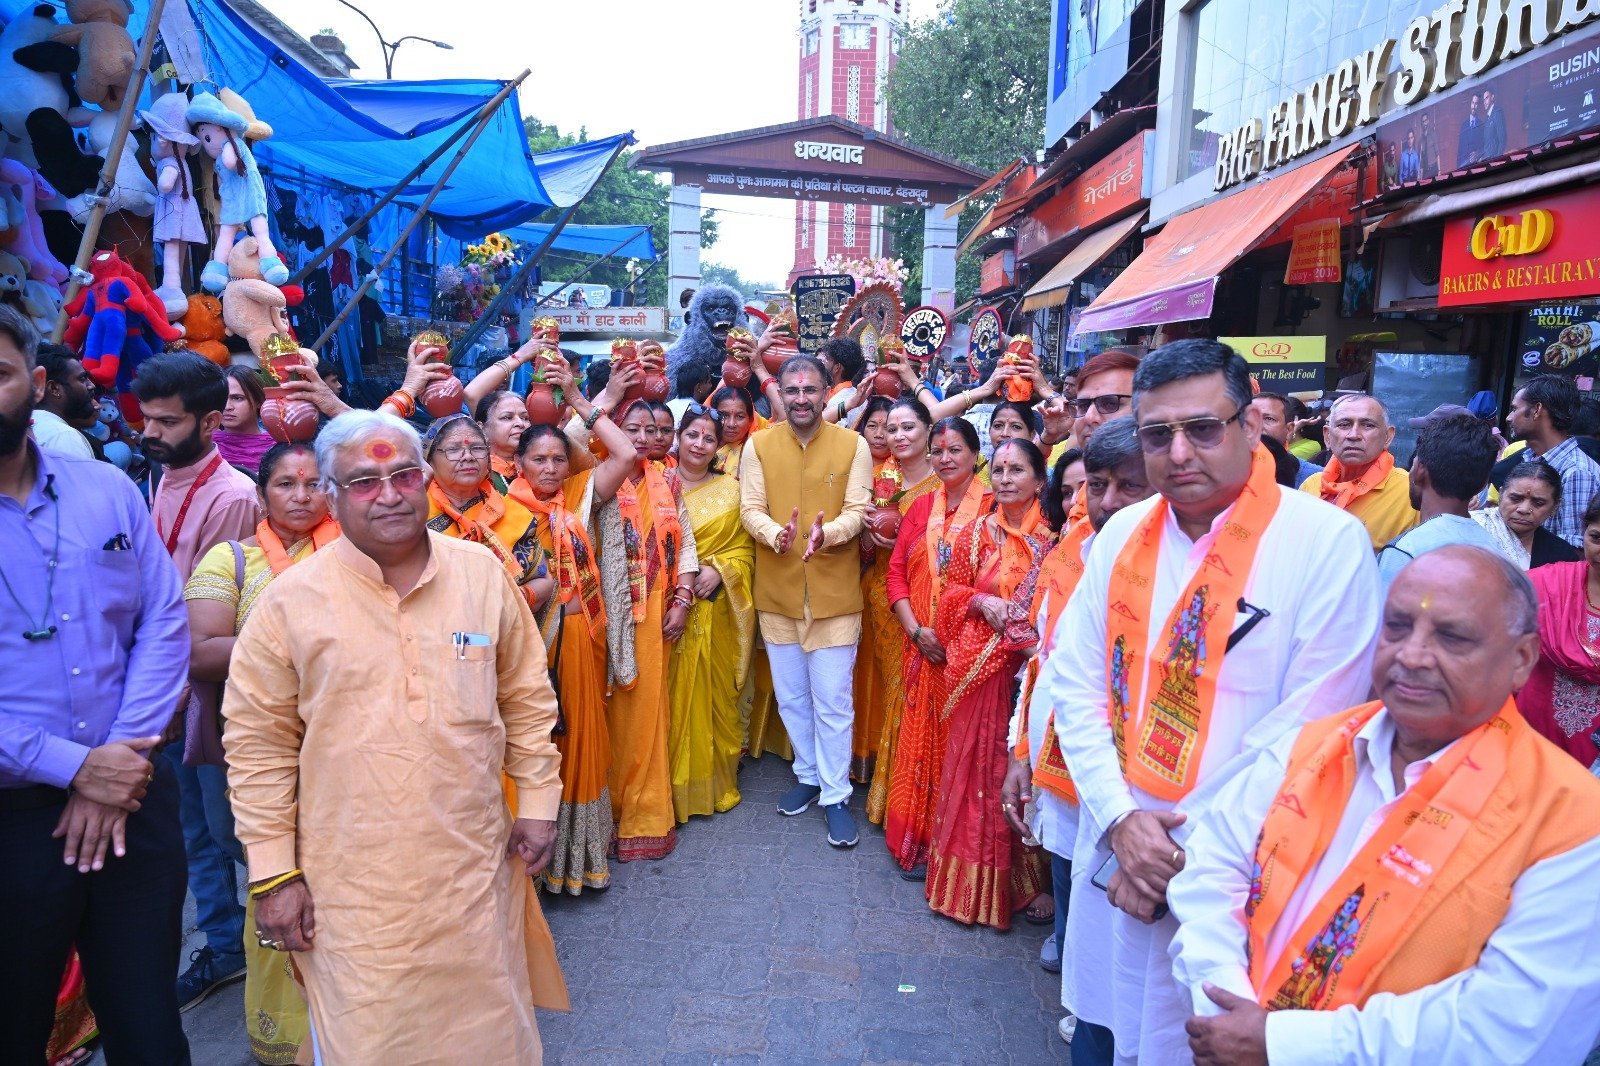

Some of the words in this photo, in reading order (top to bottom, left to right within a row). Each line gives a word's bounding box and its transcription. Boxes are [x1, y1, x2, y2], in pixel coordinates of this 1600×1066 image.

[1549, 46, 1600, 82] BUSIN
[1214, 117, 1257, 191] BIG
[1263, 39, 1393, 171] FANCY
[1394, 0, 1600, 105] STOR
[794, 140, 865, 164] धन्यवाद
[707, 172, 735, 184] आपके
[753, 177, 789, 188] आगमन
[790, 176, 803, 189] की
[832, 179, 842, 192] में
[896, 184, 929, 203] देहरादून
[1471, 208, 1554, 260] CnD
[1443, 272, 1489, 295] BAKERS
[1492, 270, 1502, 290] &
[619, 312, 647, 326] काली
[1538, 315, 1572, 326] ROLL
[1262, 368, 1277, 380] The
[1278, 368, 1295, 380] Best
[1296, 368, 1317, 379] Food
